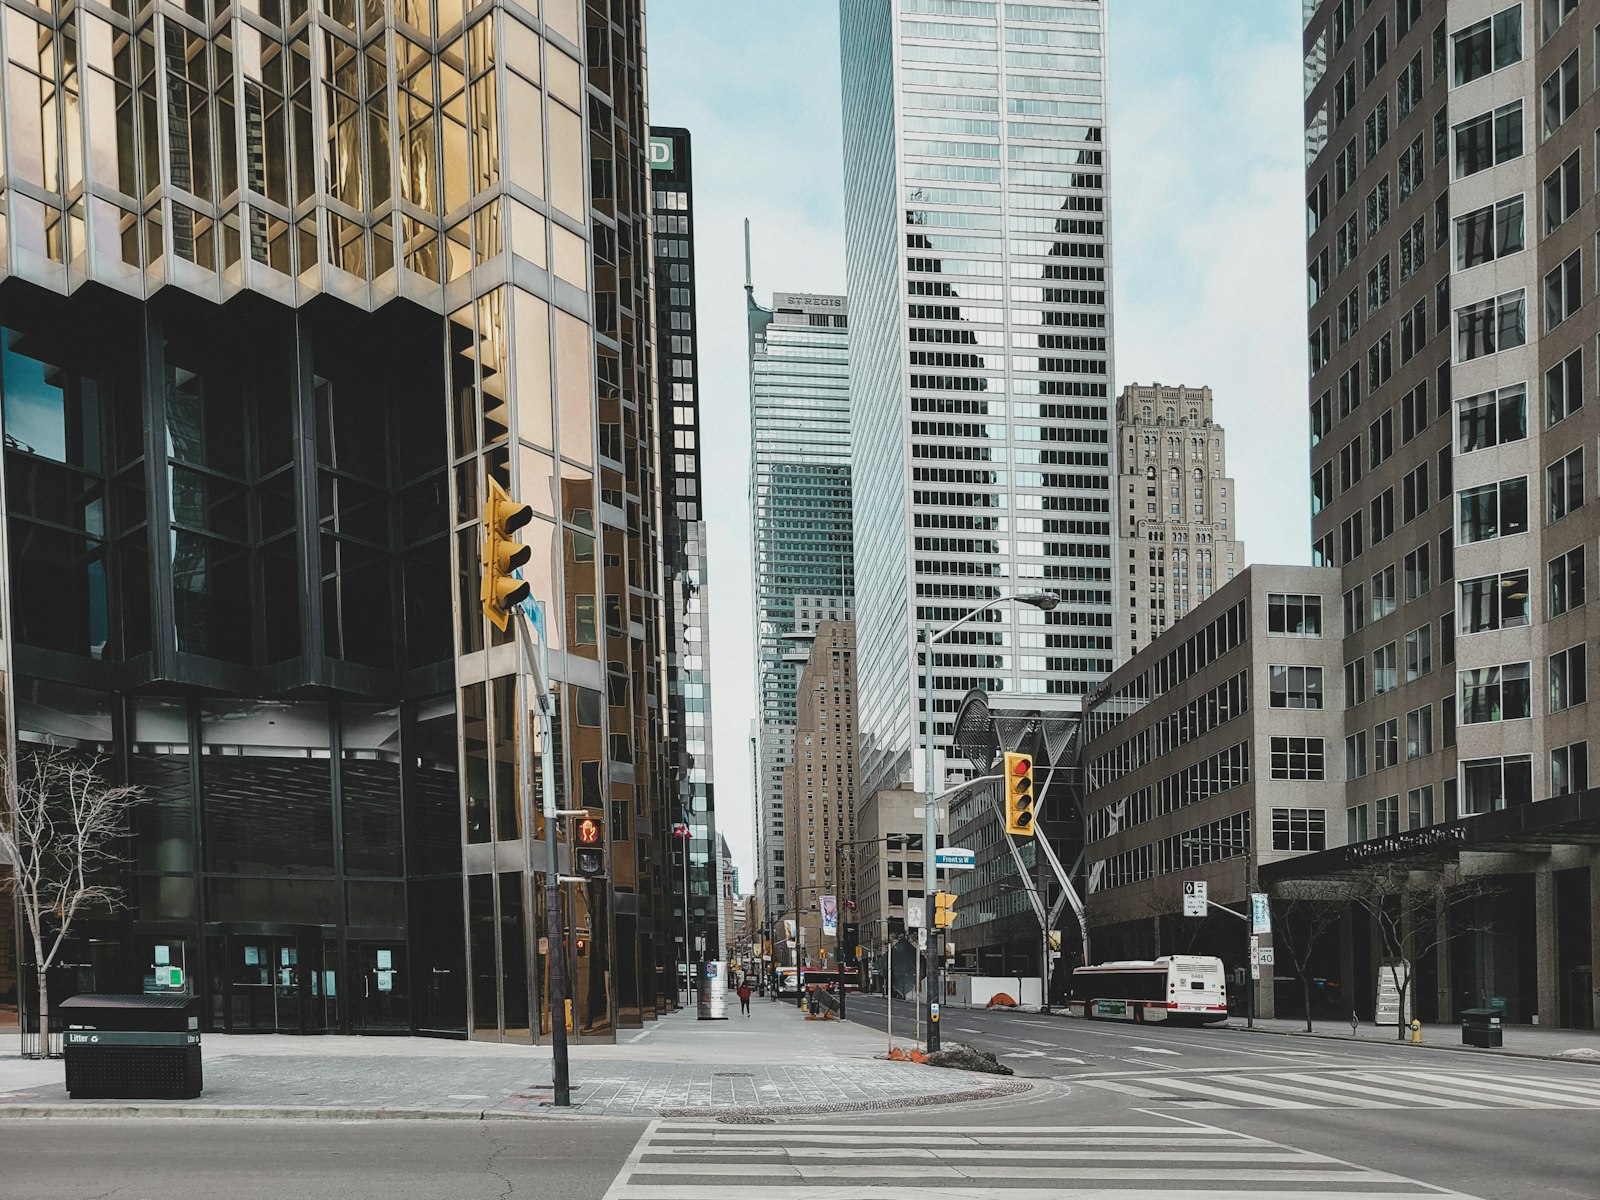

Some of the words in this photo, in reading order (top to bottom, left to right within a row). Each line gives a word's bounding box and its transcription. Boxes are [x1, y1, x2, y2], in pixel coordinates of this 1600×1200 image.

[649, 142, 669, 162] D
[1260, 954, 1272, 962] 40
[70, 1034, 88, 1042] Litter
